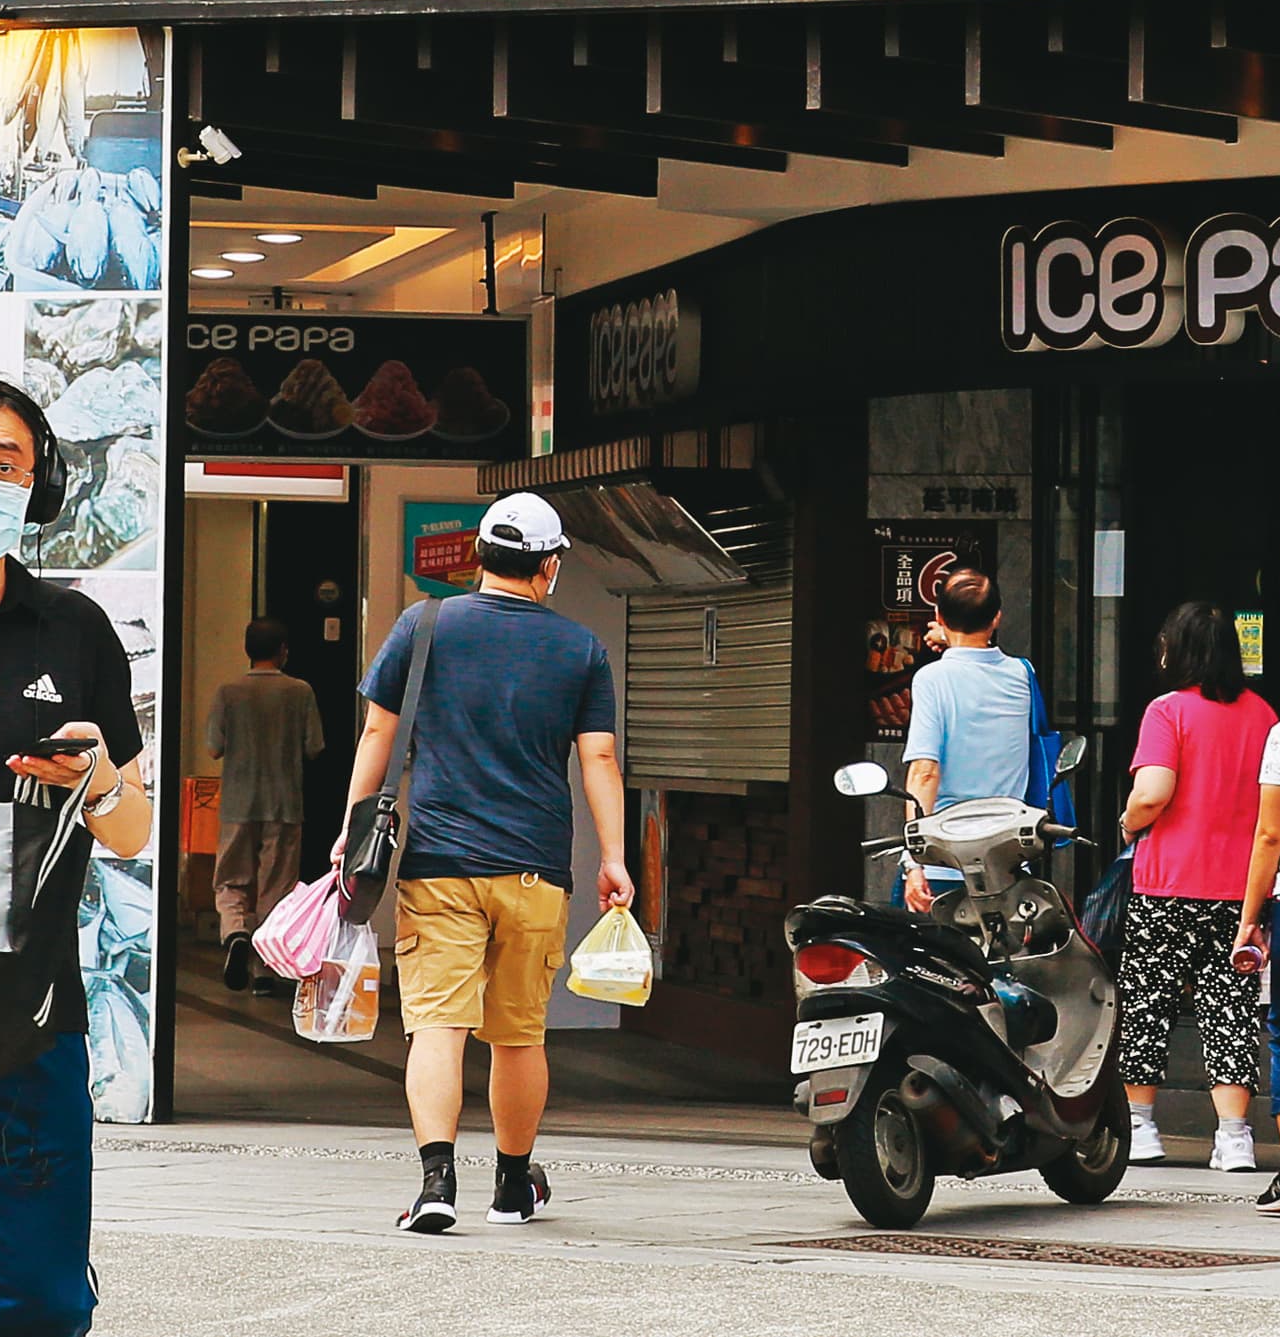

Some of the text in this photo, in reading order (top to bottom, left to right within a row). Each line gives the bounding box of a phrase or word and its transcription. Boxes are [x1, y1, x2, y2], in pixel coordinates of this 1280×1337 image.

[896, 553, 913, 604] 全品項
[23, 688, 63, 704] adidas
[796, 1029, 878, 1064] 729-EDH
